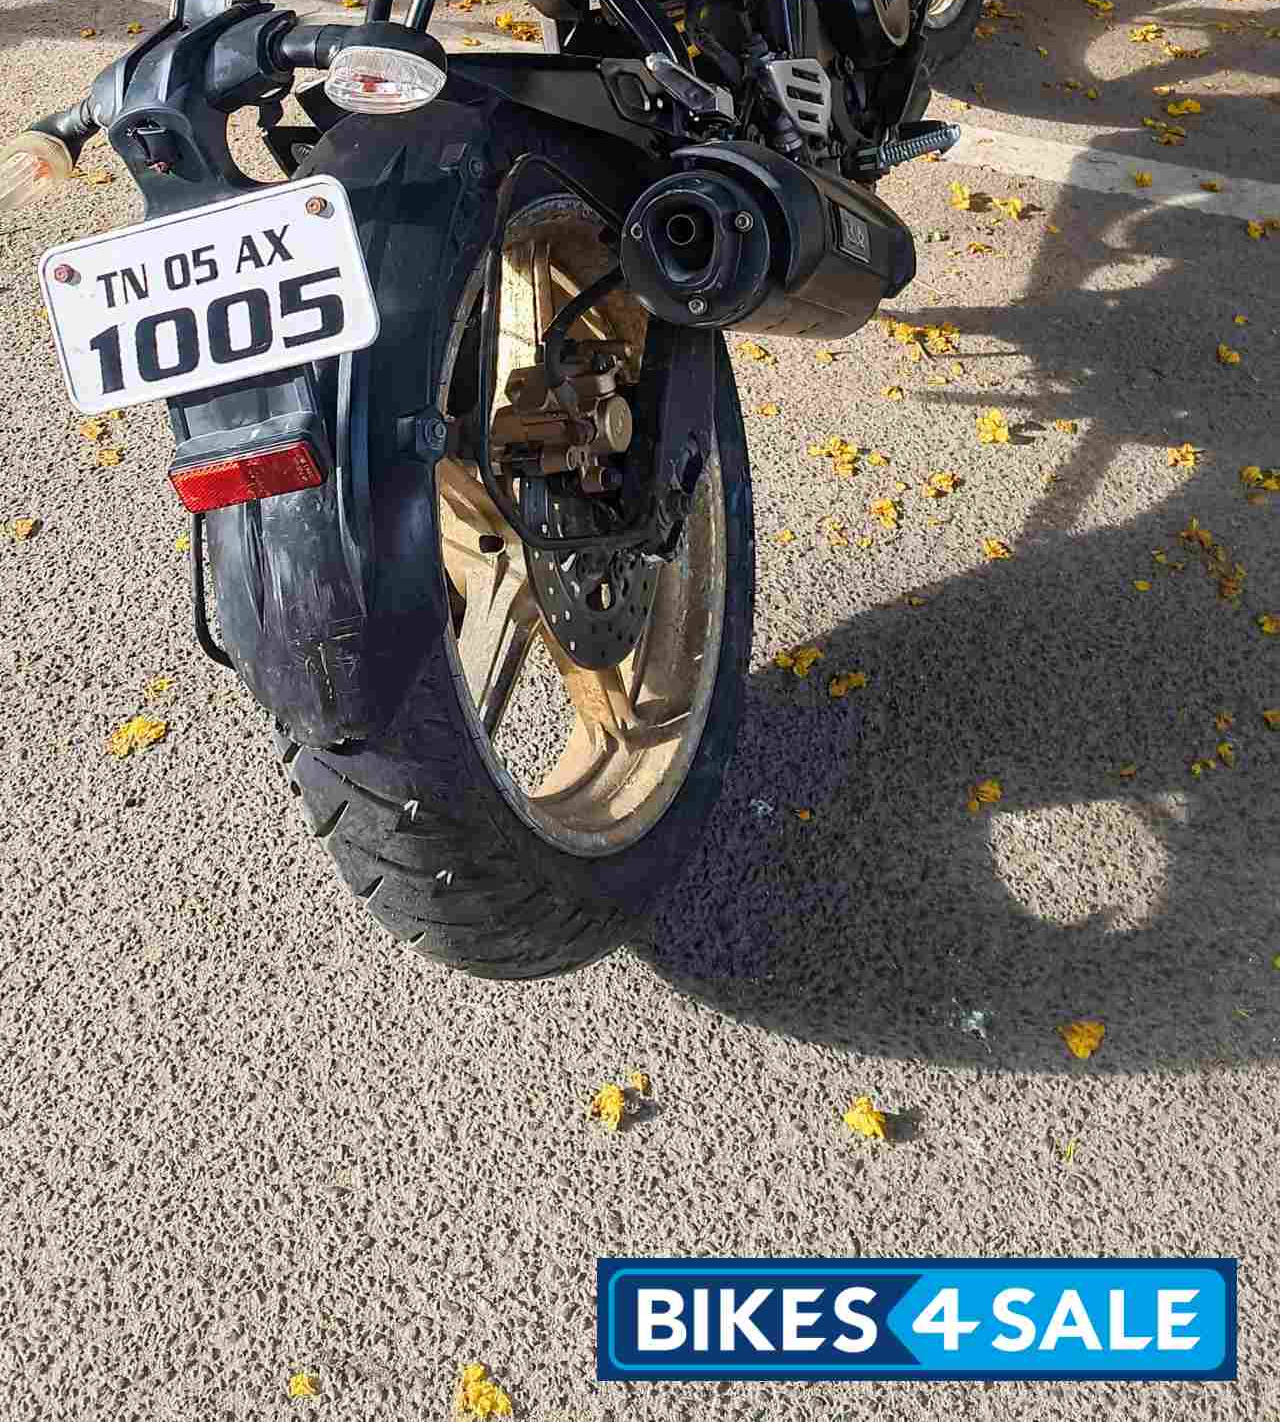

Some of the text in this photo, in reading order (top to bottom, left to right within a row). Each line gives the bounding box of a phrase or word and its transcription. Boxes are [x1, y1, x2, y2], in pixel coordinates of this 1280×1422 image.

[97, 225, 294, 308] TN 05 AX
[90, 267, 344, 394] 1005
